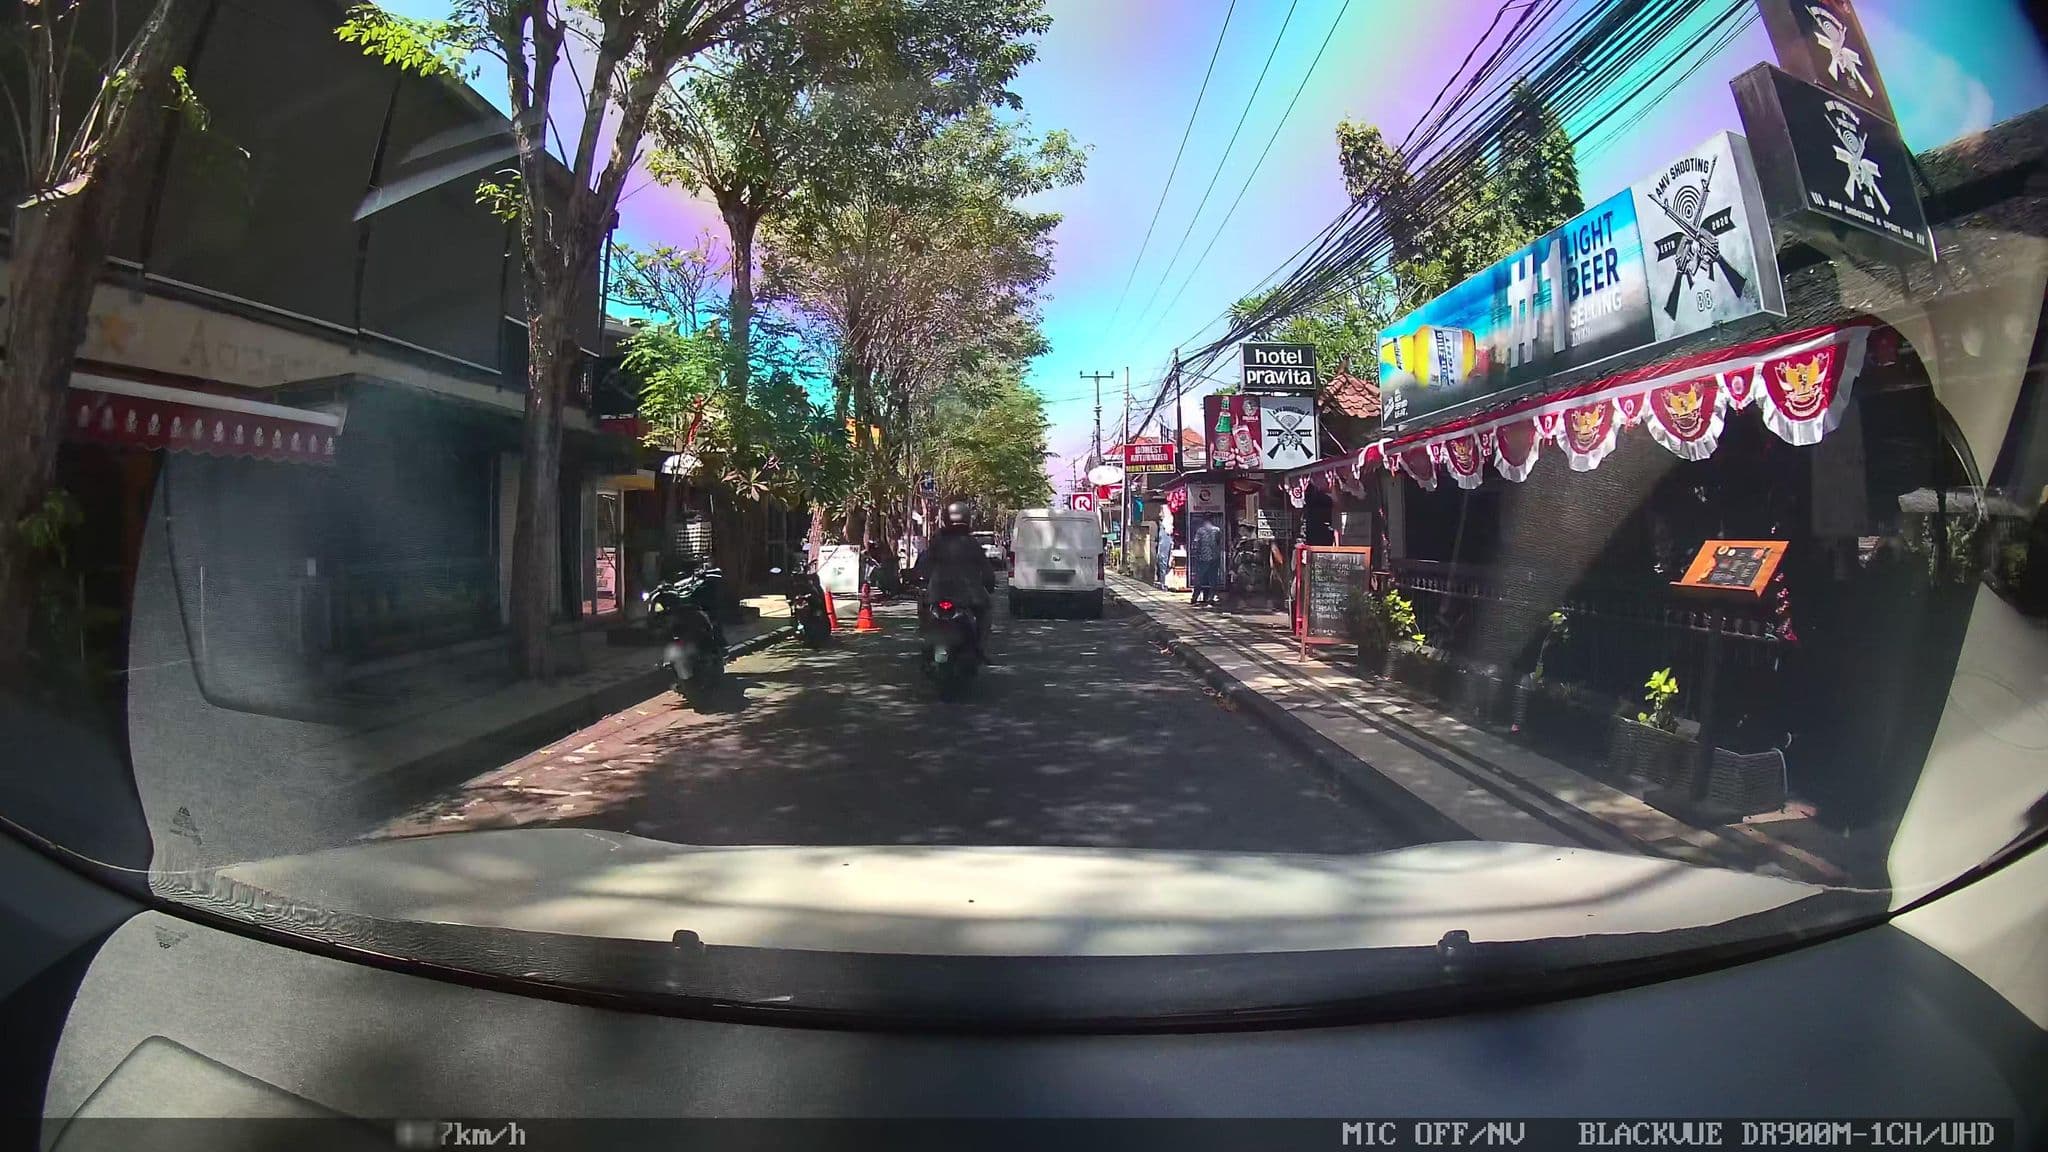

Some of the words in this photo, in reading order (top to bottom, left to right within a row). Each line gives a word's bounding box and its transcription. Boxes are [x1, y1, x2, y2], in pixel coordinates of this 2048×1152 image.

[1655, 173, 1670, 198] AMV
[1670, 157, 1709, 180] SHOOTING
[1565, 210, 1614, 263] LIGHT
[1711, 216, 1729, 231] 2020
[1567, 247, 1621, 303] BEER
[1570, 292, 1623, 329] SELLING
[1696, 289, 1713, 312] 88
[1255, 349, 1302, 364] hotel
